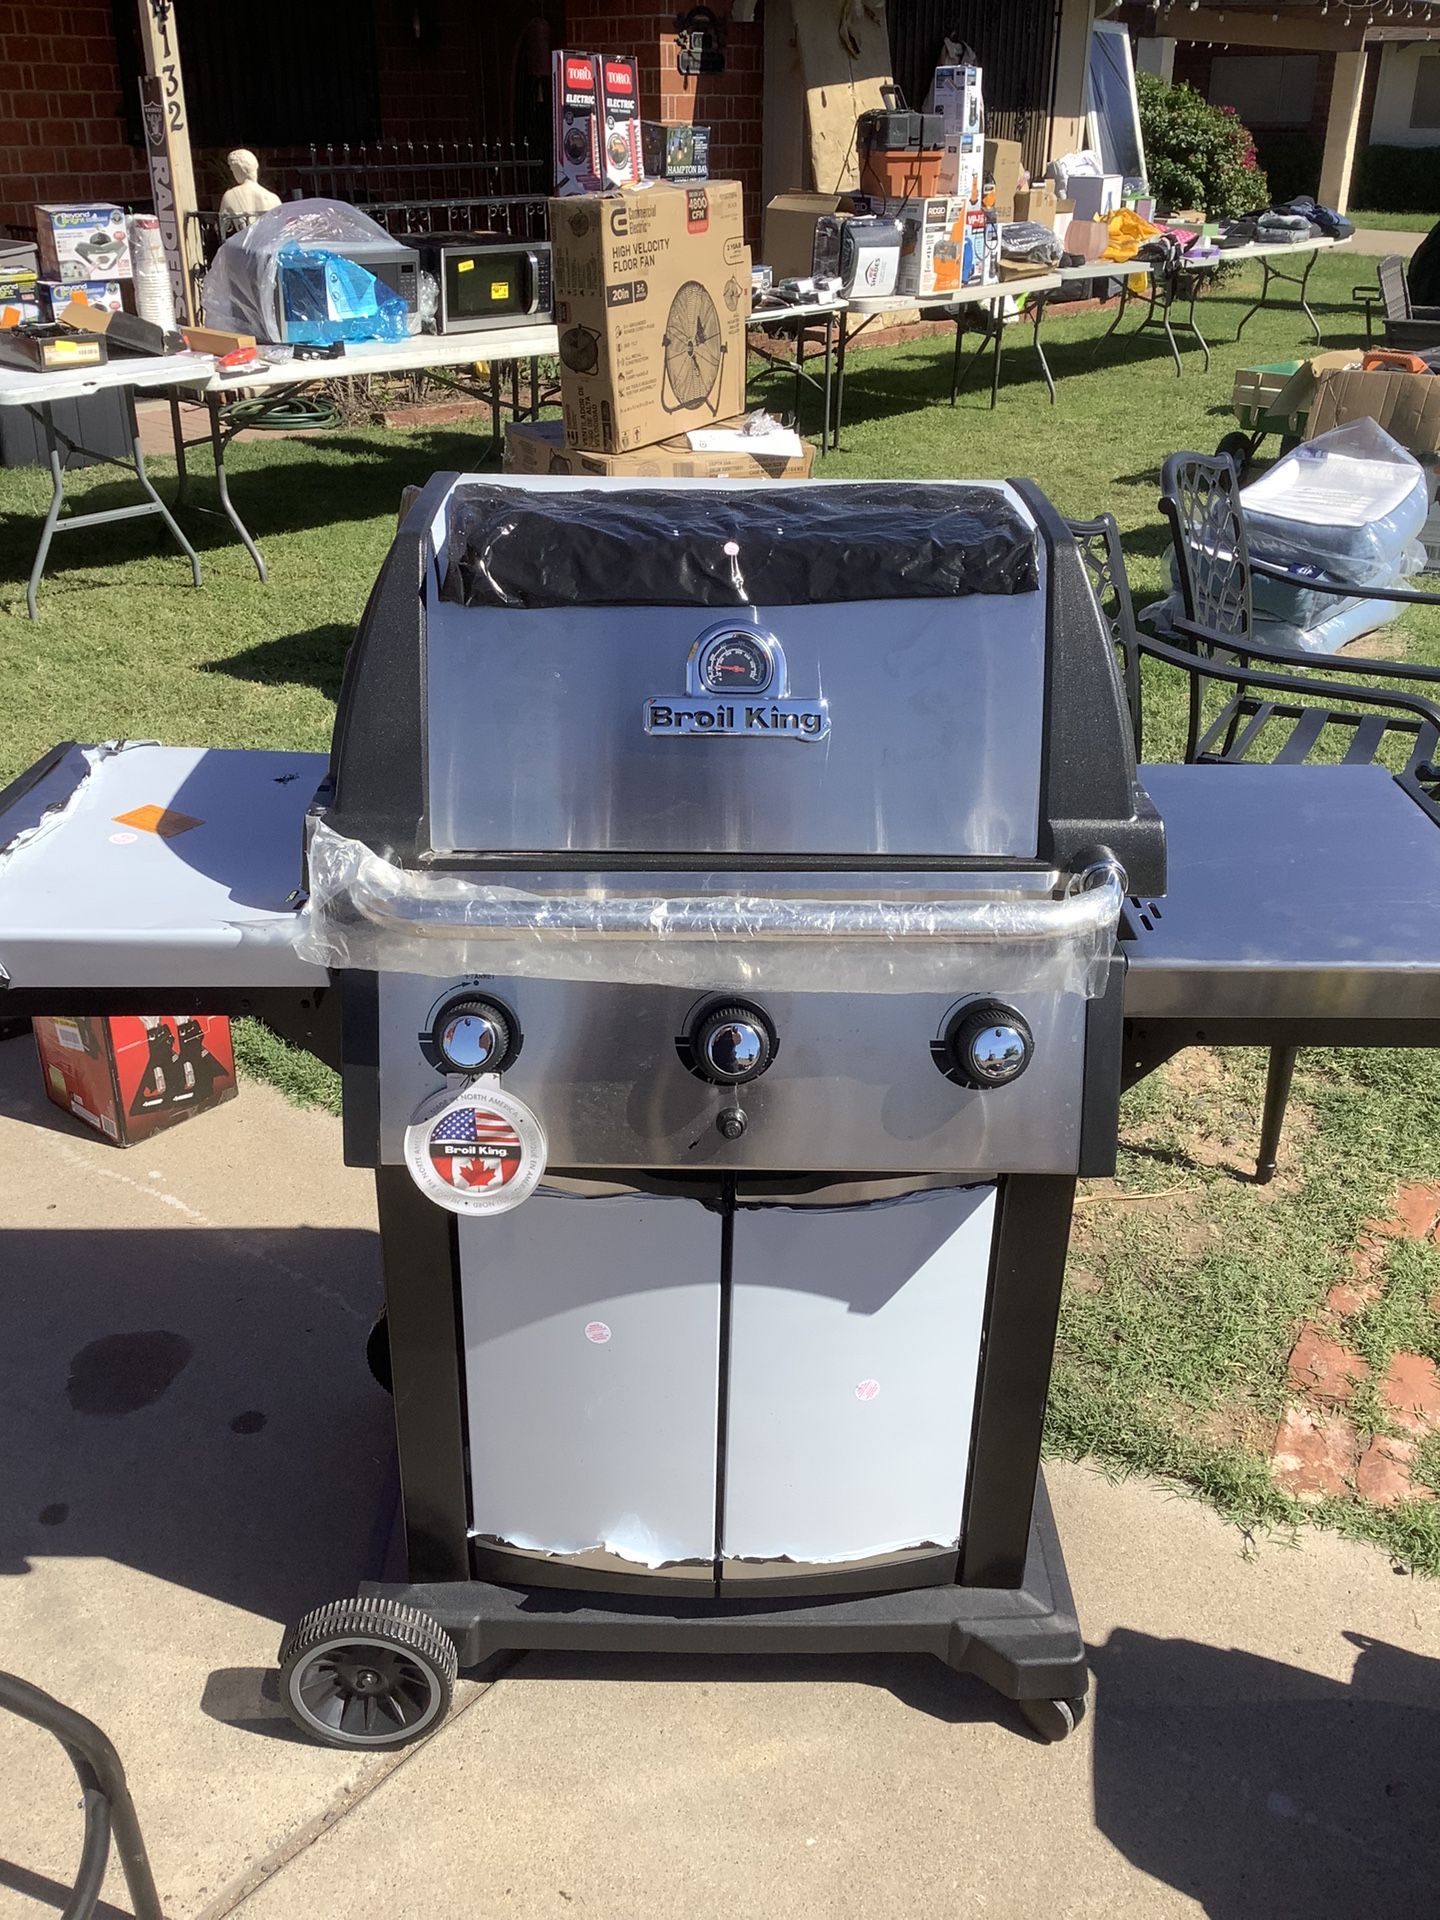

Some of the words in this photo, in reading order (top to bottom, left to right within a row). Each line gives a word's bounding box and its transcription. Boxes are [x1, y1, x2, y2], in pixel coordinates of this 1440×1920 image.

[566, 93, 595, 104] ELECTRIC
[607, 98, 635, 109] ELECTRIC
[667, 165, 697, 174] HAMPTON
[688, 197, 707, 210] 4800
[628, 204, 656, 220] Commercial
[152, 156, 188, 323] RAIDERS
[612, 245, 631, 258] HIGH
[633, 238, 670, 255] VELOCITY
[613, 257, 638, 273] FLOOR
[640, 255, 656, 268] FAN
[871, 258, 881, 287] SHADES
[612, 287, 630, 300] 20in
[650, 705, 734, 728] Broil
[745, 706, 821, 735] King
[489, 1097, 518, 1118] AMERICA
[444, 1145, 476, 1154] Broil
[478, 1146, 507, 1157] King
